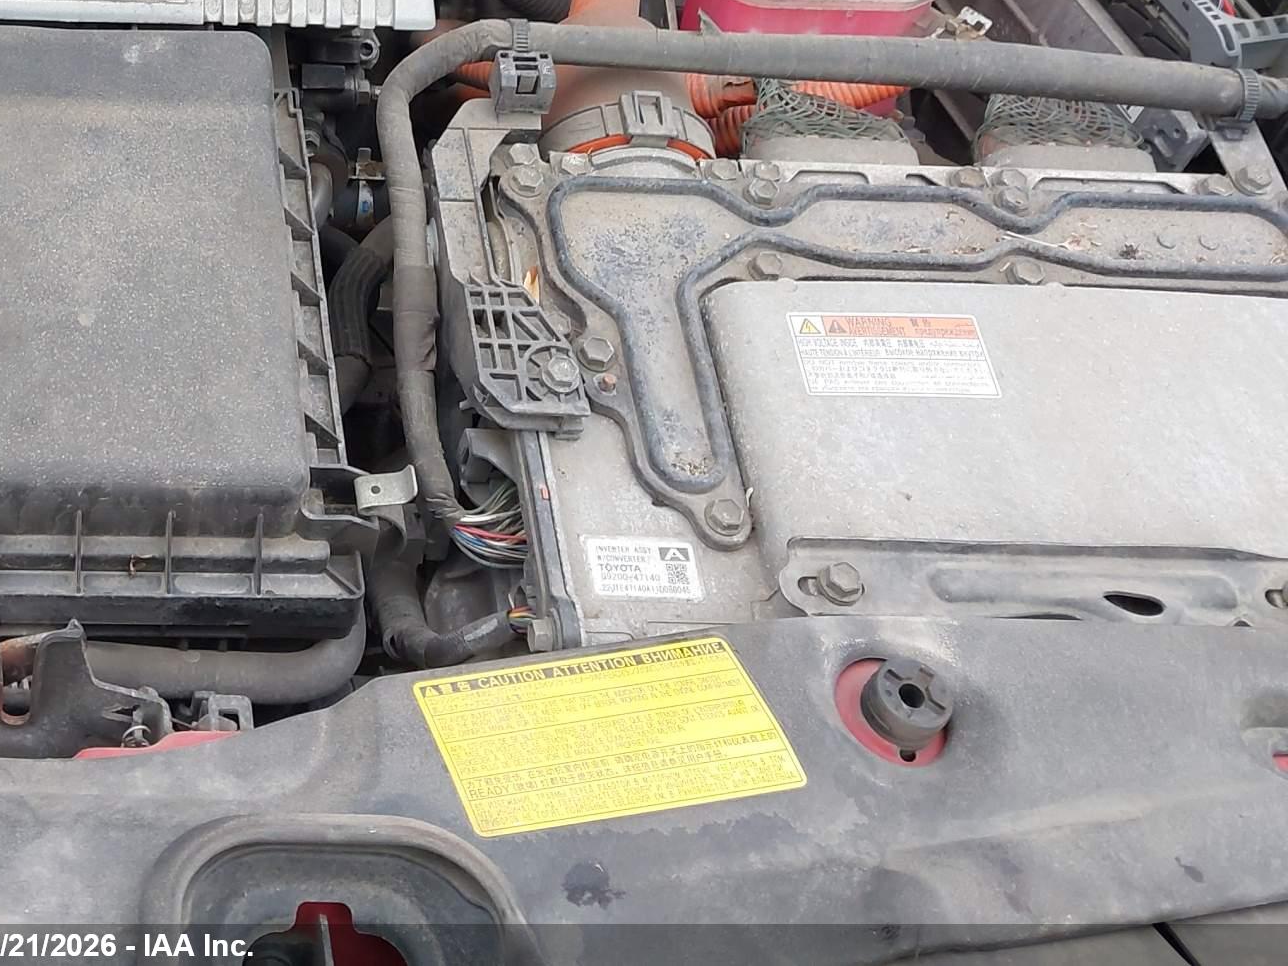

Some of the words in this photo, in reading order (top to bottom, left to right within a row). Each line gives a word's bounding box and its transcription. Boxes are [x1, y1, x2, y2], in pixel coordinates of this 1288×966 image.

[599, 563, 641, 572] TOYOTA
[640, 642, 723, 663] ВНИМАНИЕ
[476, 669, 546, 688] CAUTION
[550, 656, 637, 677] ATTENTION
[468, 784, 510, 798] READY
